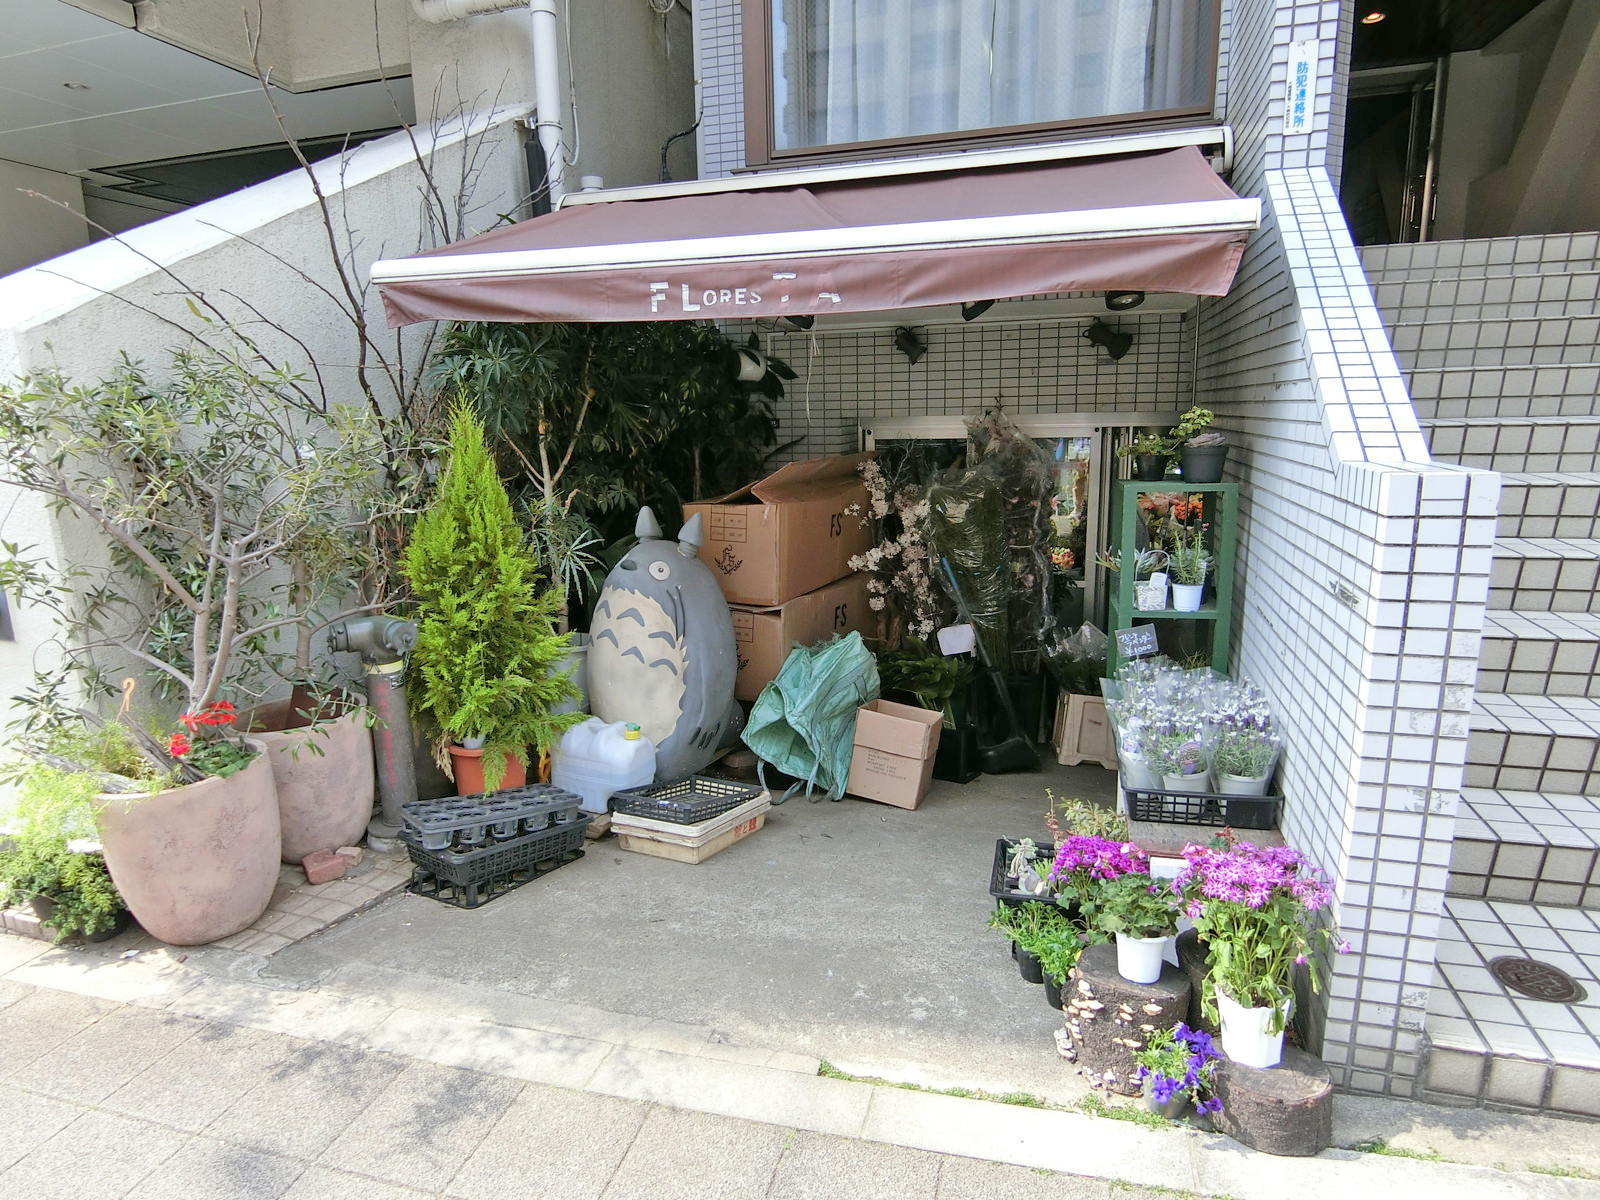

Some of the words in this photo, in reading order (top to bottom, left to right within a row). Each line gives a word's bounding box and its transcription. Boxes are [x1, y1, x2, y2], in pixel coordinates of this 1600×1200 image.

[1293, 61, 1308, 127] 防犯連絡所
[830, 512, 842, 538] FS
[834, 603, 847, 629] FS
